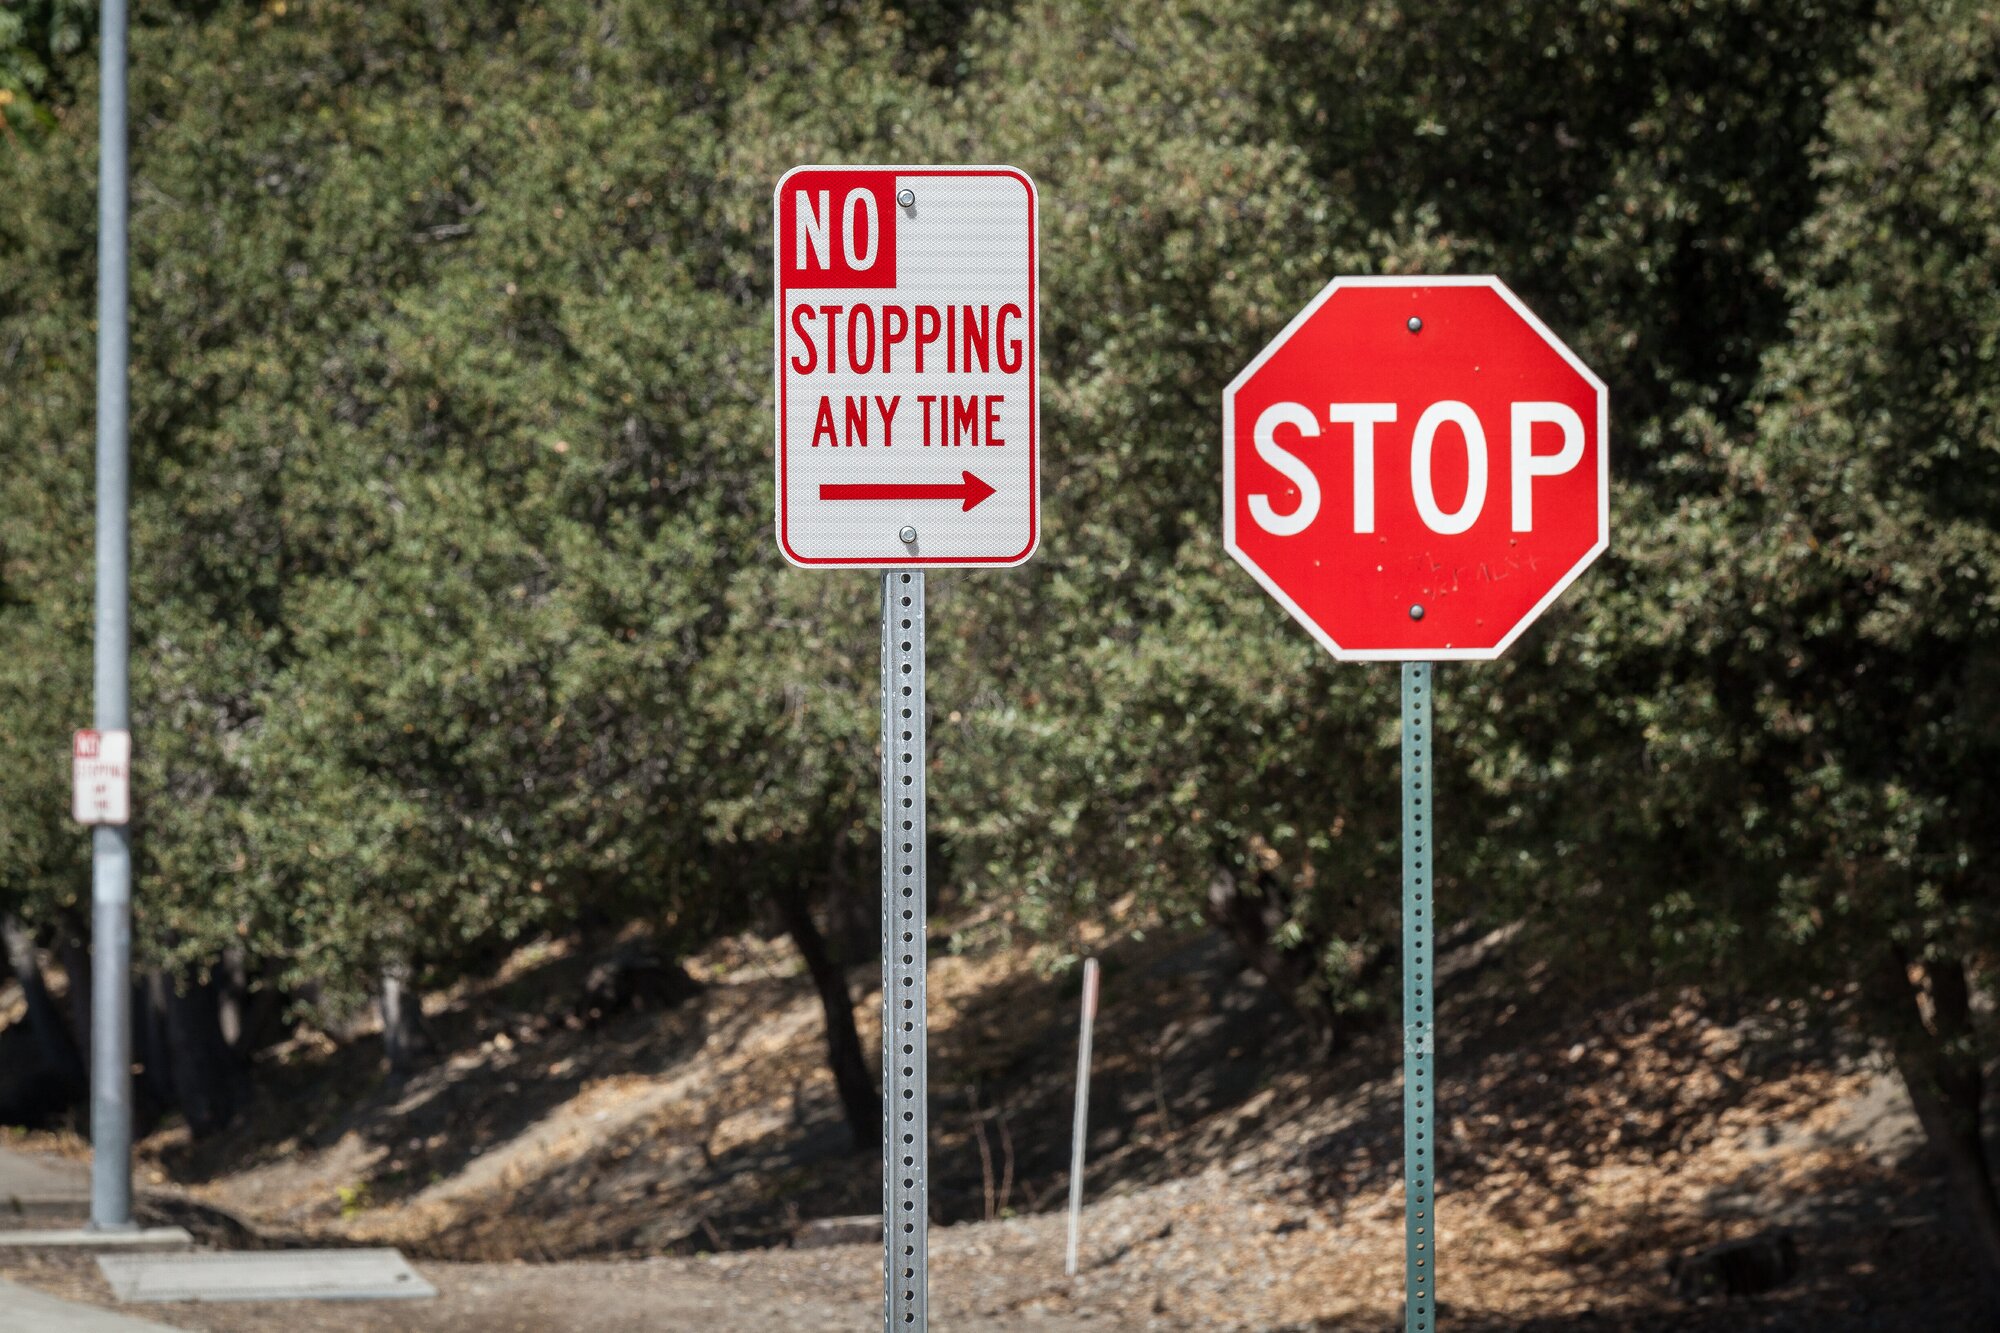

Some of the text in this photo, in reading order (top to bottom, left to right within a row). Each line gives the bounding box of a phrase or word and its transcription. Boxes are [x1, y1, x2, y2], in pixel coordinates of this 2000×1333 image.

[795, 187, 879, 271] NO
[791, 303, 1023, 375] STOPPING
[812, 394, 1005, 447] ANY TIME
[1247, 400, 1586, 537] STOP
